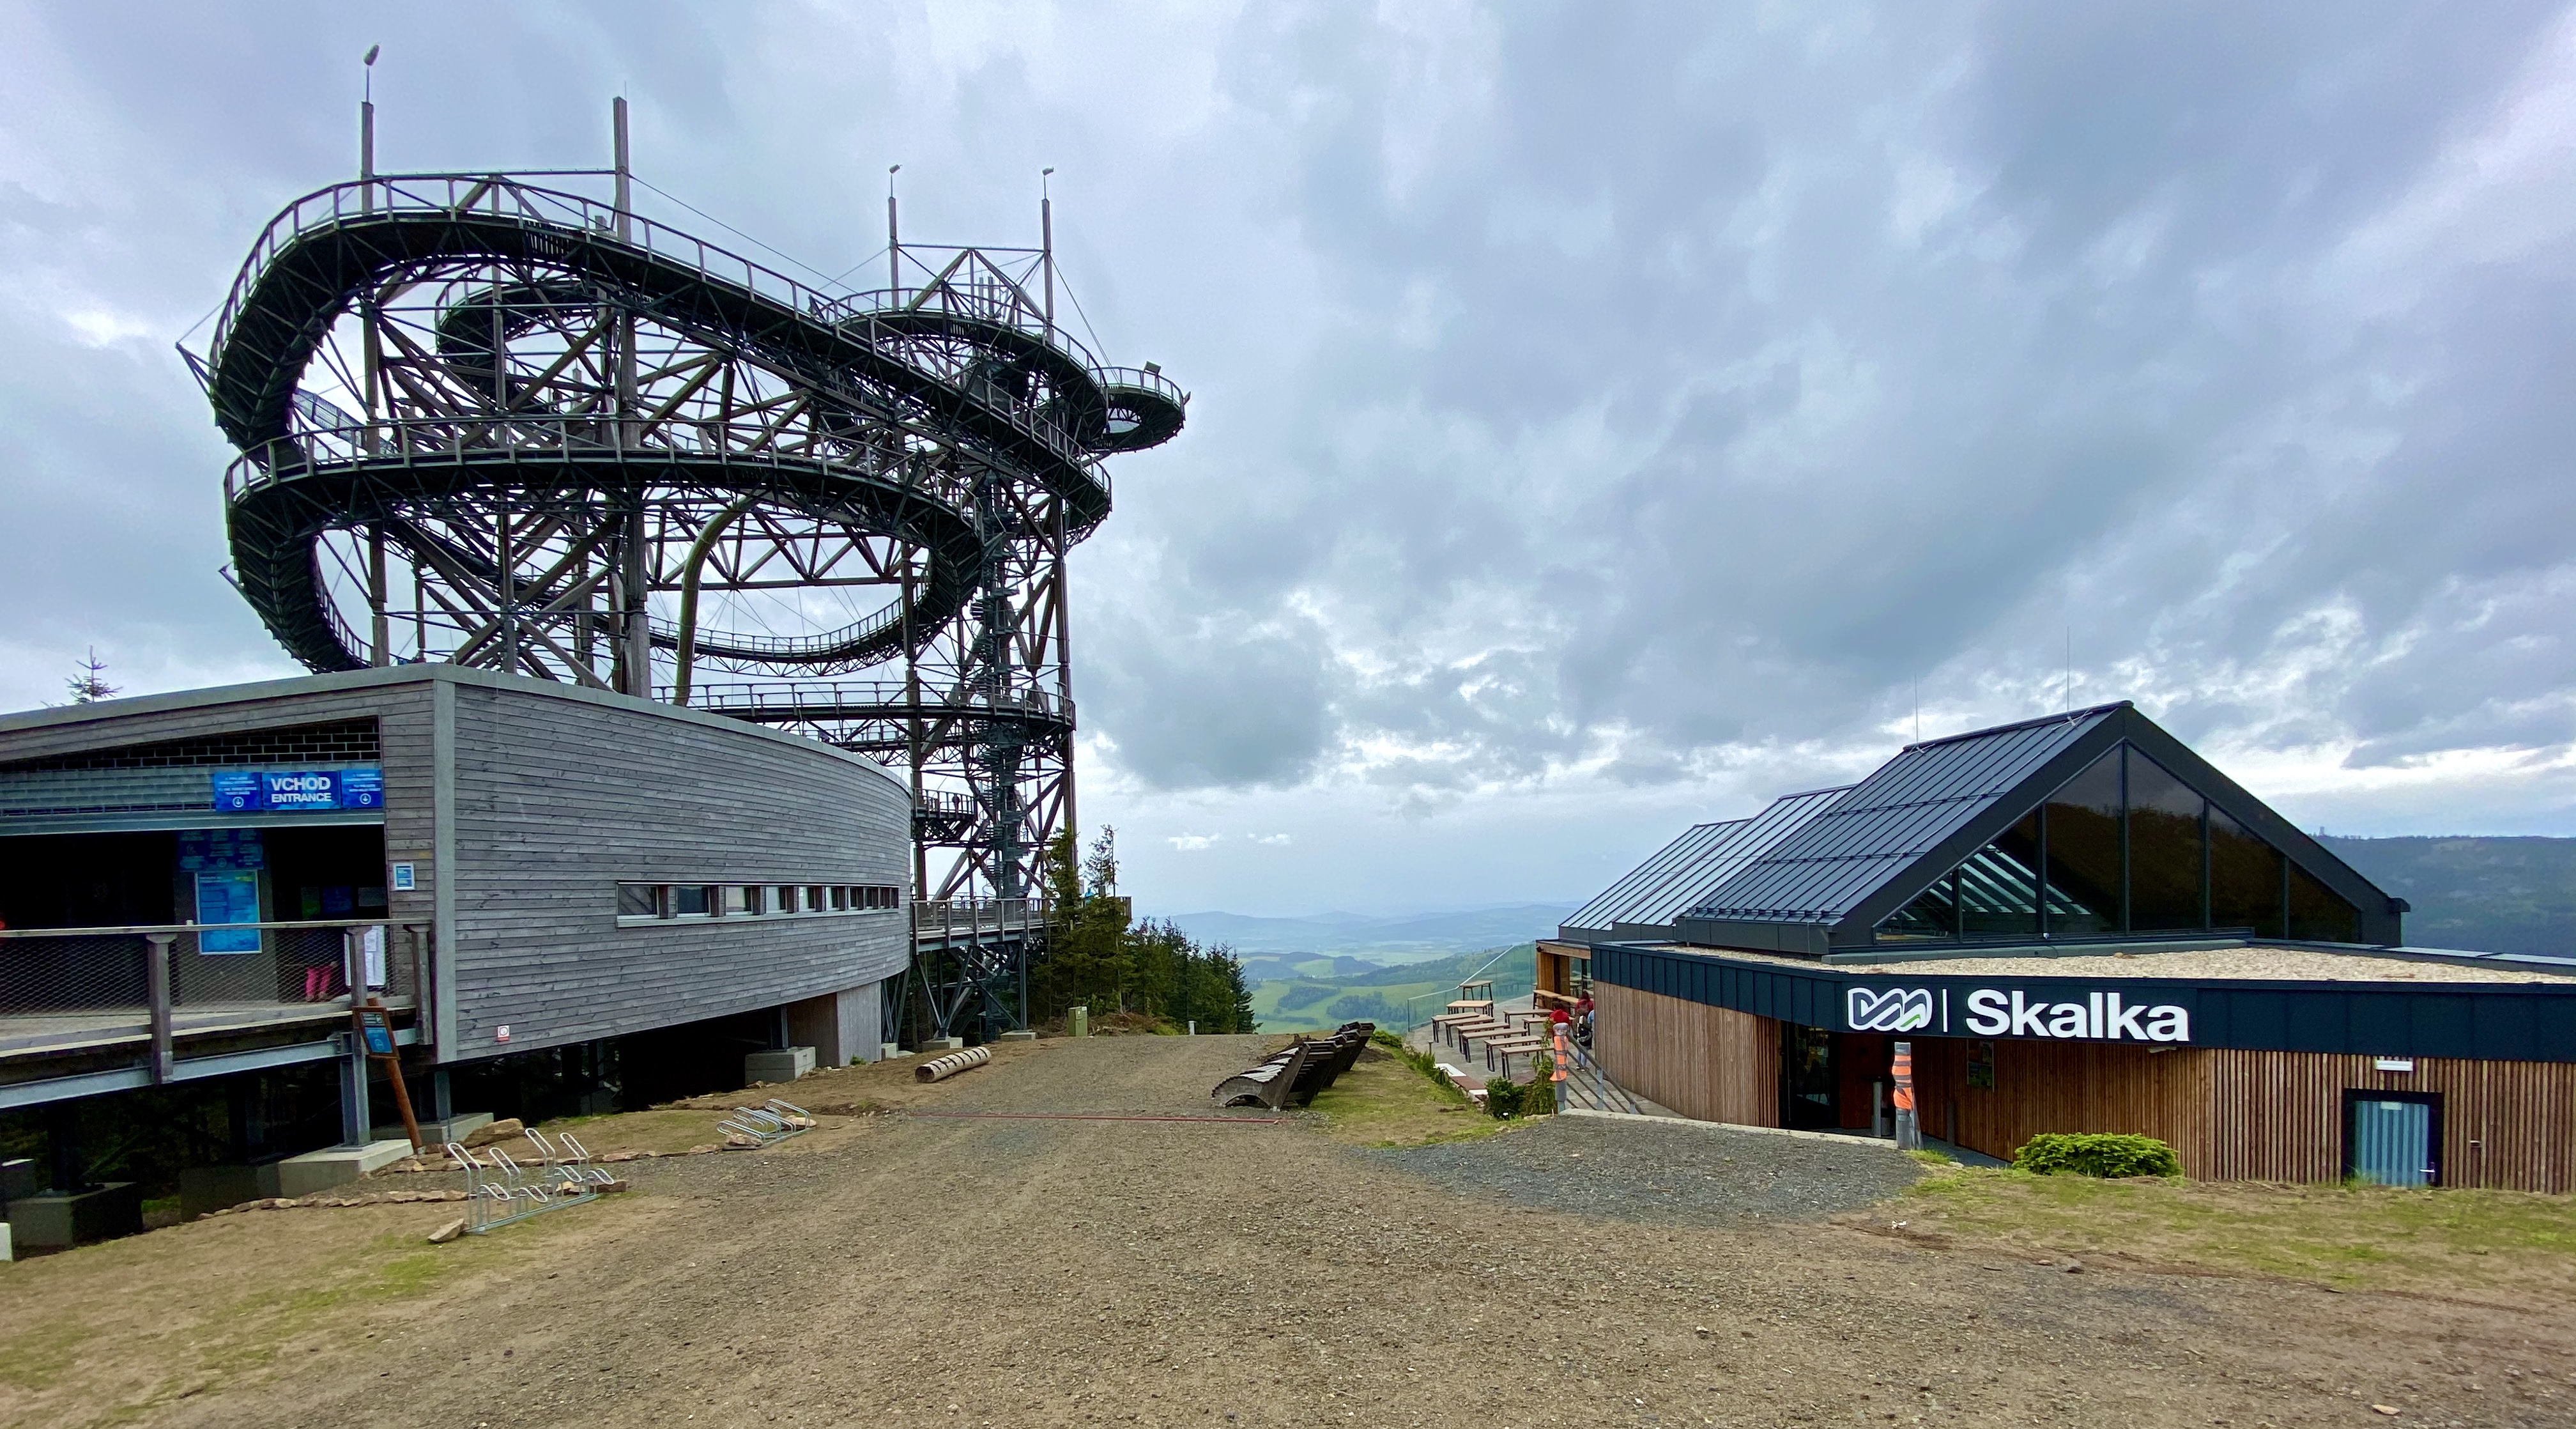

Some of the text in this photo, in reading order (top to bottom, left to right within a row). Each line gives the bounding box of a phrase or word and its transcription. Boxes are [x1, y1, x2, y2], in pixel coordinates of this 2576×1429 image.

[271, 777, 331, 791] VCHOD
[271, 792, 332, 803] ENTRANCE
[1966, 989, 2189, 1042] Skalka
